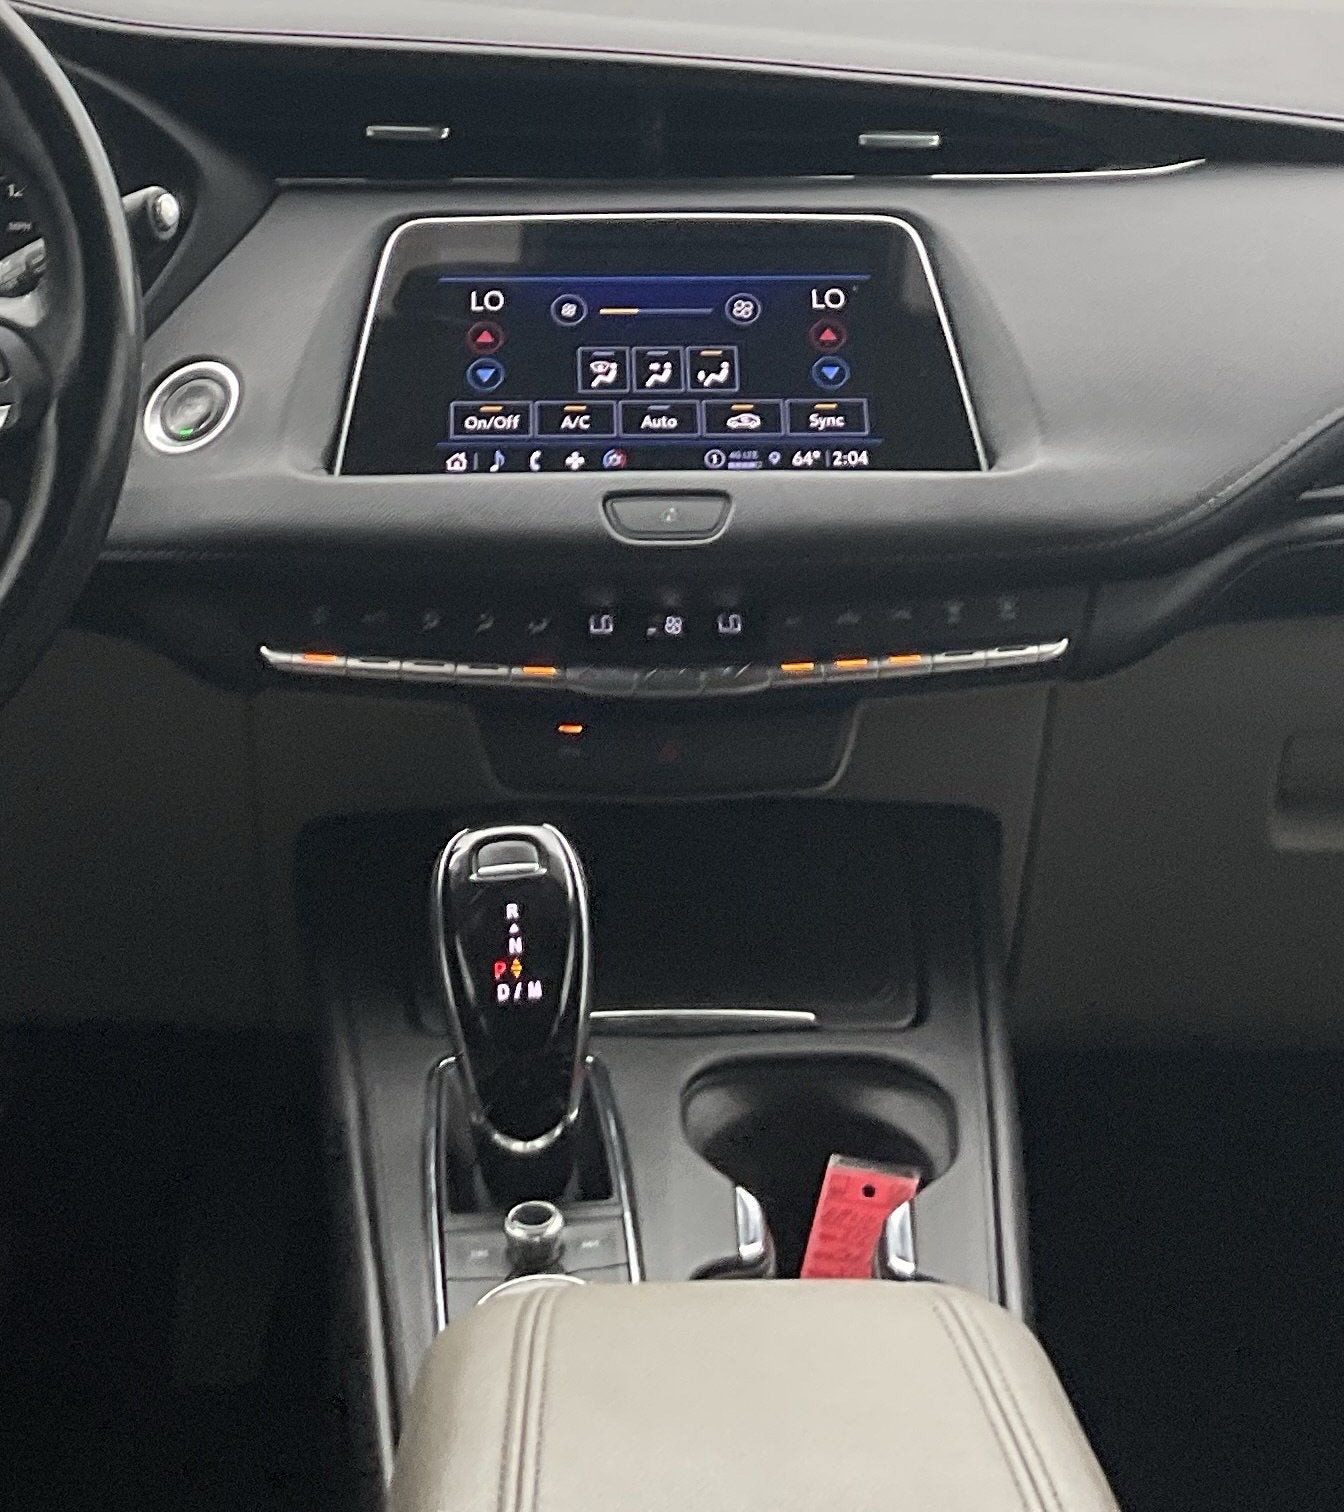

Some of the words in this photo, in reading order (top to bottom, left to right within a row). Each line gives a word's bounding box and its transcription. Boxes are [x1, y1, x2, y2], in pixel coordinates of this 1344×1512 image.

[470, 290, 505, 312] LO
[811, 288, 846, 310] LO
[464, 413, 521, 430] On/Off
[560, 414, 592, 430] A/C
[640, 414, 679, 430] Auto
[808, 412, 846, 430] Sync
[791, 449, 822, 467] 64°
[832, 449, 870, 467] 2:04
[506, 903, 519, 919] R
[509, 937, 523, 954] N
[494, 960, 507, 978] P
